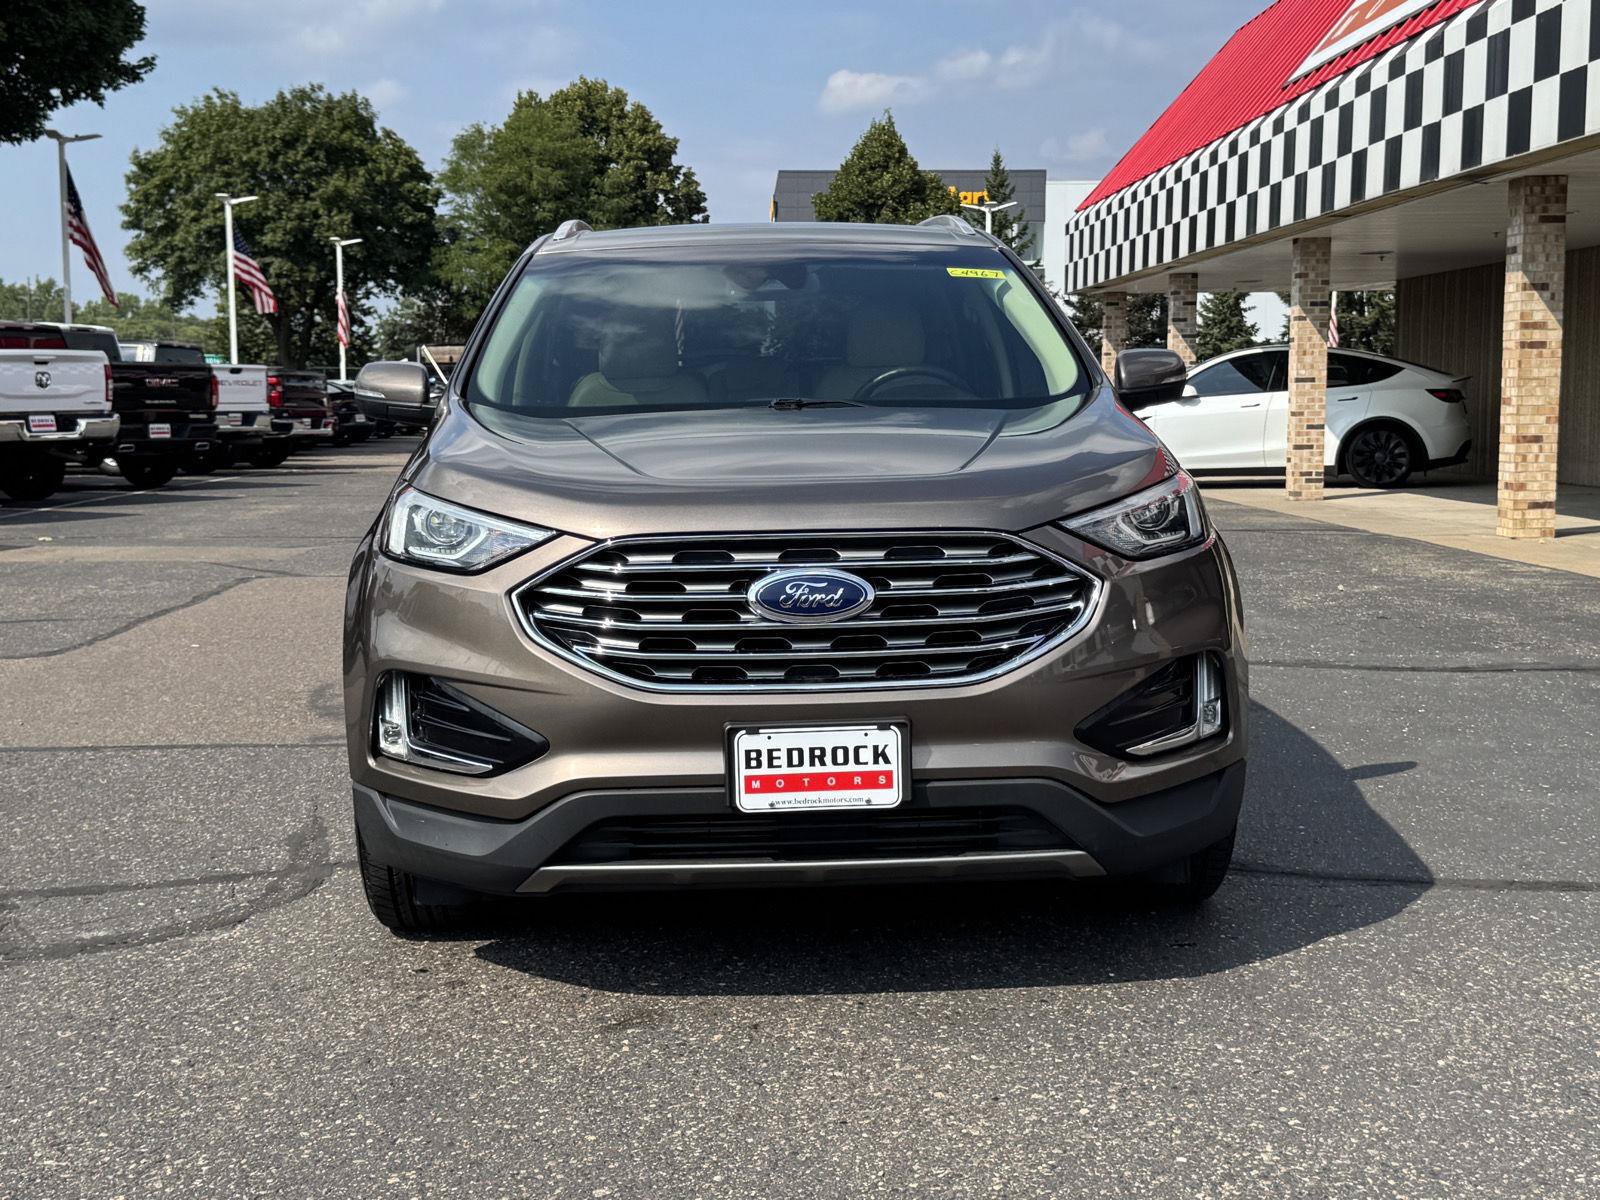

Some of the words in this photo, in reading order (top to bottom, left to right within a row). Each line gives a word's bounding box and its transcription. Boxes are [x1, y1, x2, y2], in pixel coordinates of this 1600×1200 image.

[779, 581, 845, 609] Ford
[744, 744, 892, 770] BEDROCK
[751, 775, 887, 789] MOTORS
[774, 796, 865, 806] www.bedrockmotors.com
